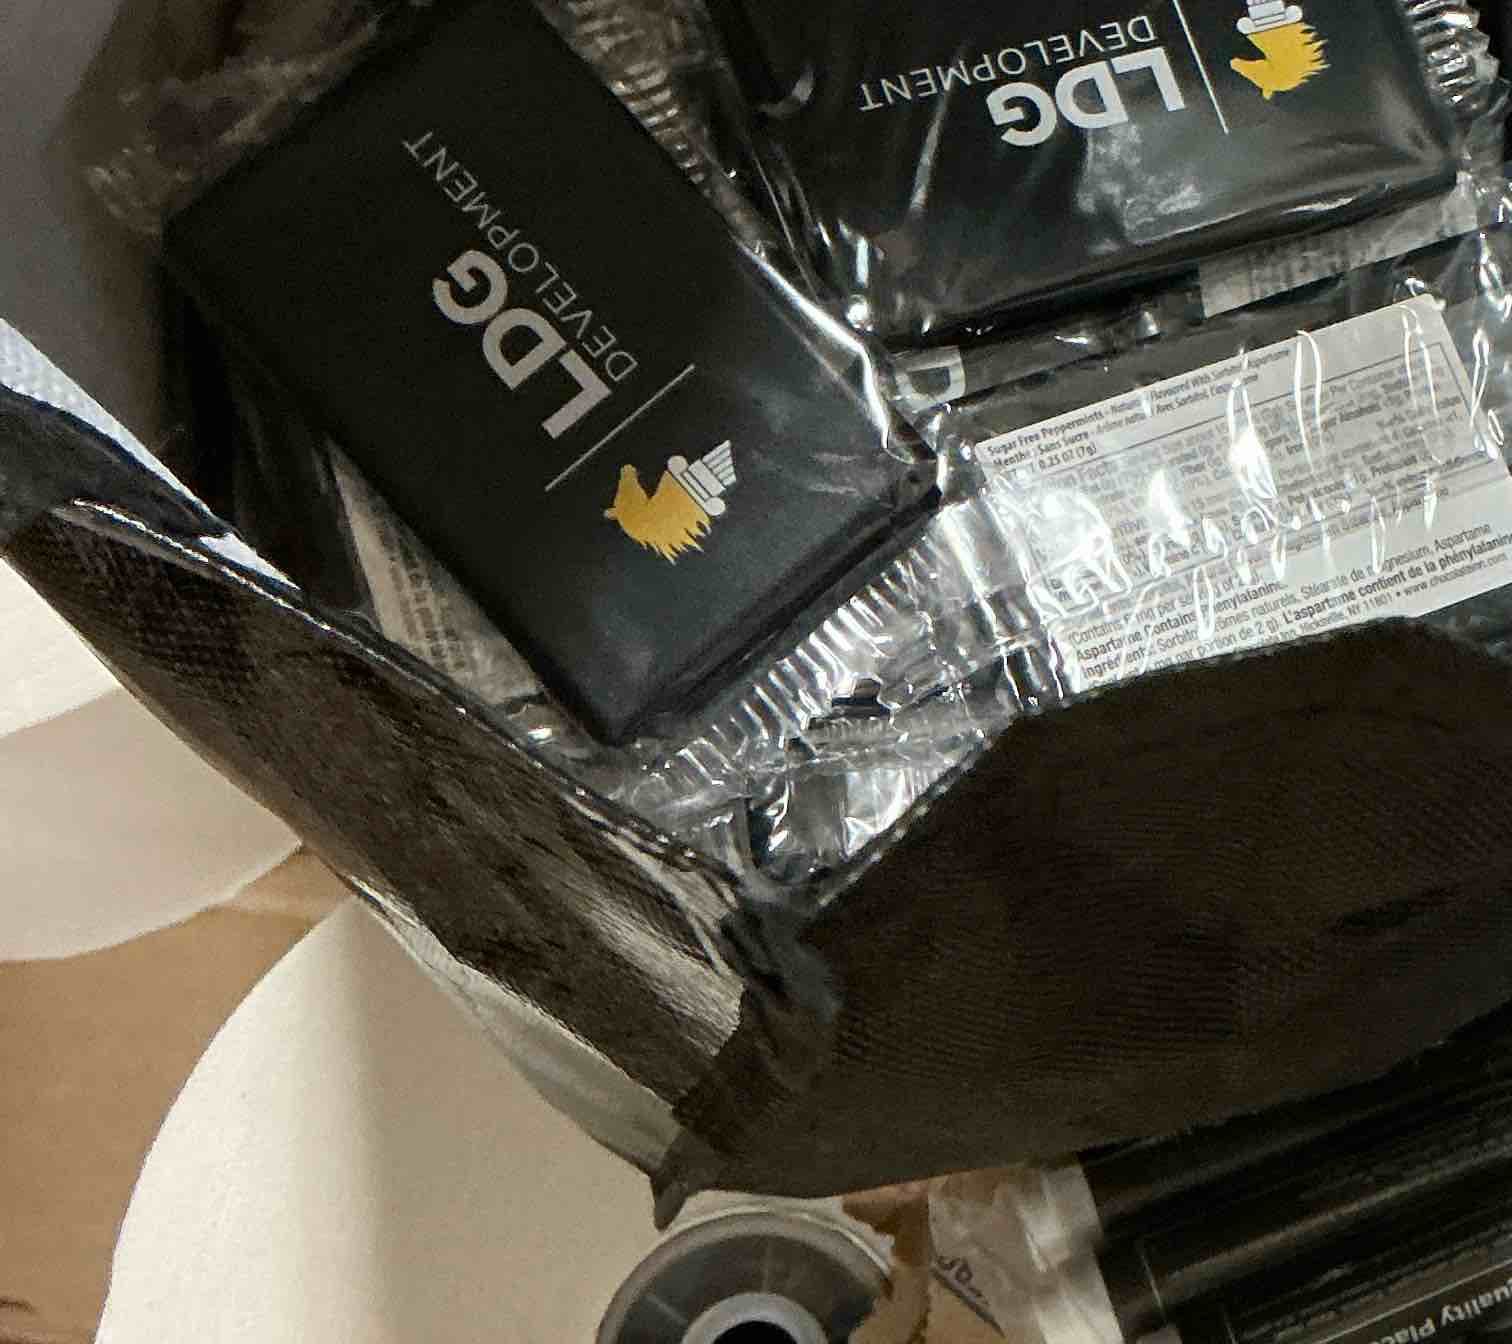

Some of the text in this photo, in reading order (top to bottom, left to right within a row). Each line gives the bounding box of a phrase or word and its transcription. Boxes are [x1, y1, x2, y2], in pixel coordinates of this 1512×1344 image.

[857, 15, 1157, 112] DEVELOPMENT
[986, 47, 1185, 147] LDG
[402, 130, 639, 384] DEVELOPMENT
[433, 249, 613, 440] LDG
[1358, 571, 1407, 597] contient
[1407, 564, 1423, 580] de
[1425, 560, 1438, 574] la
